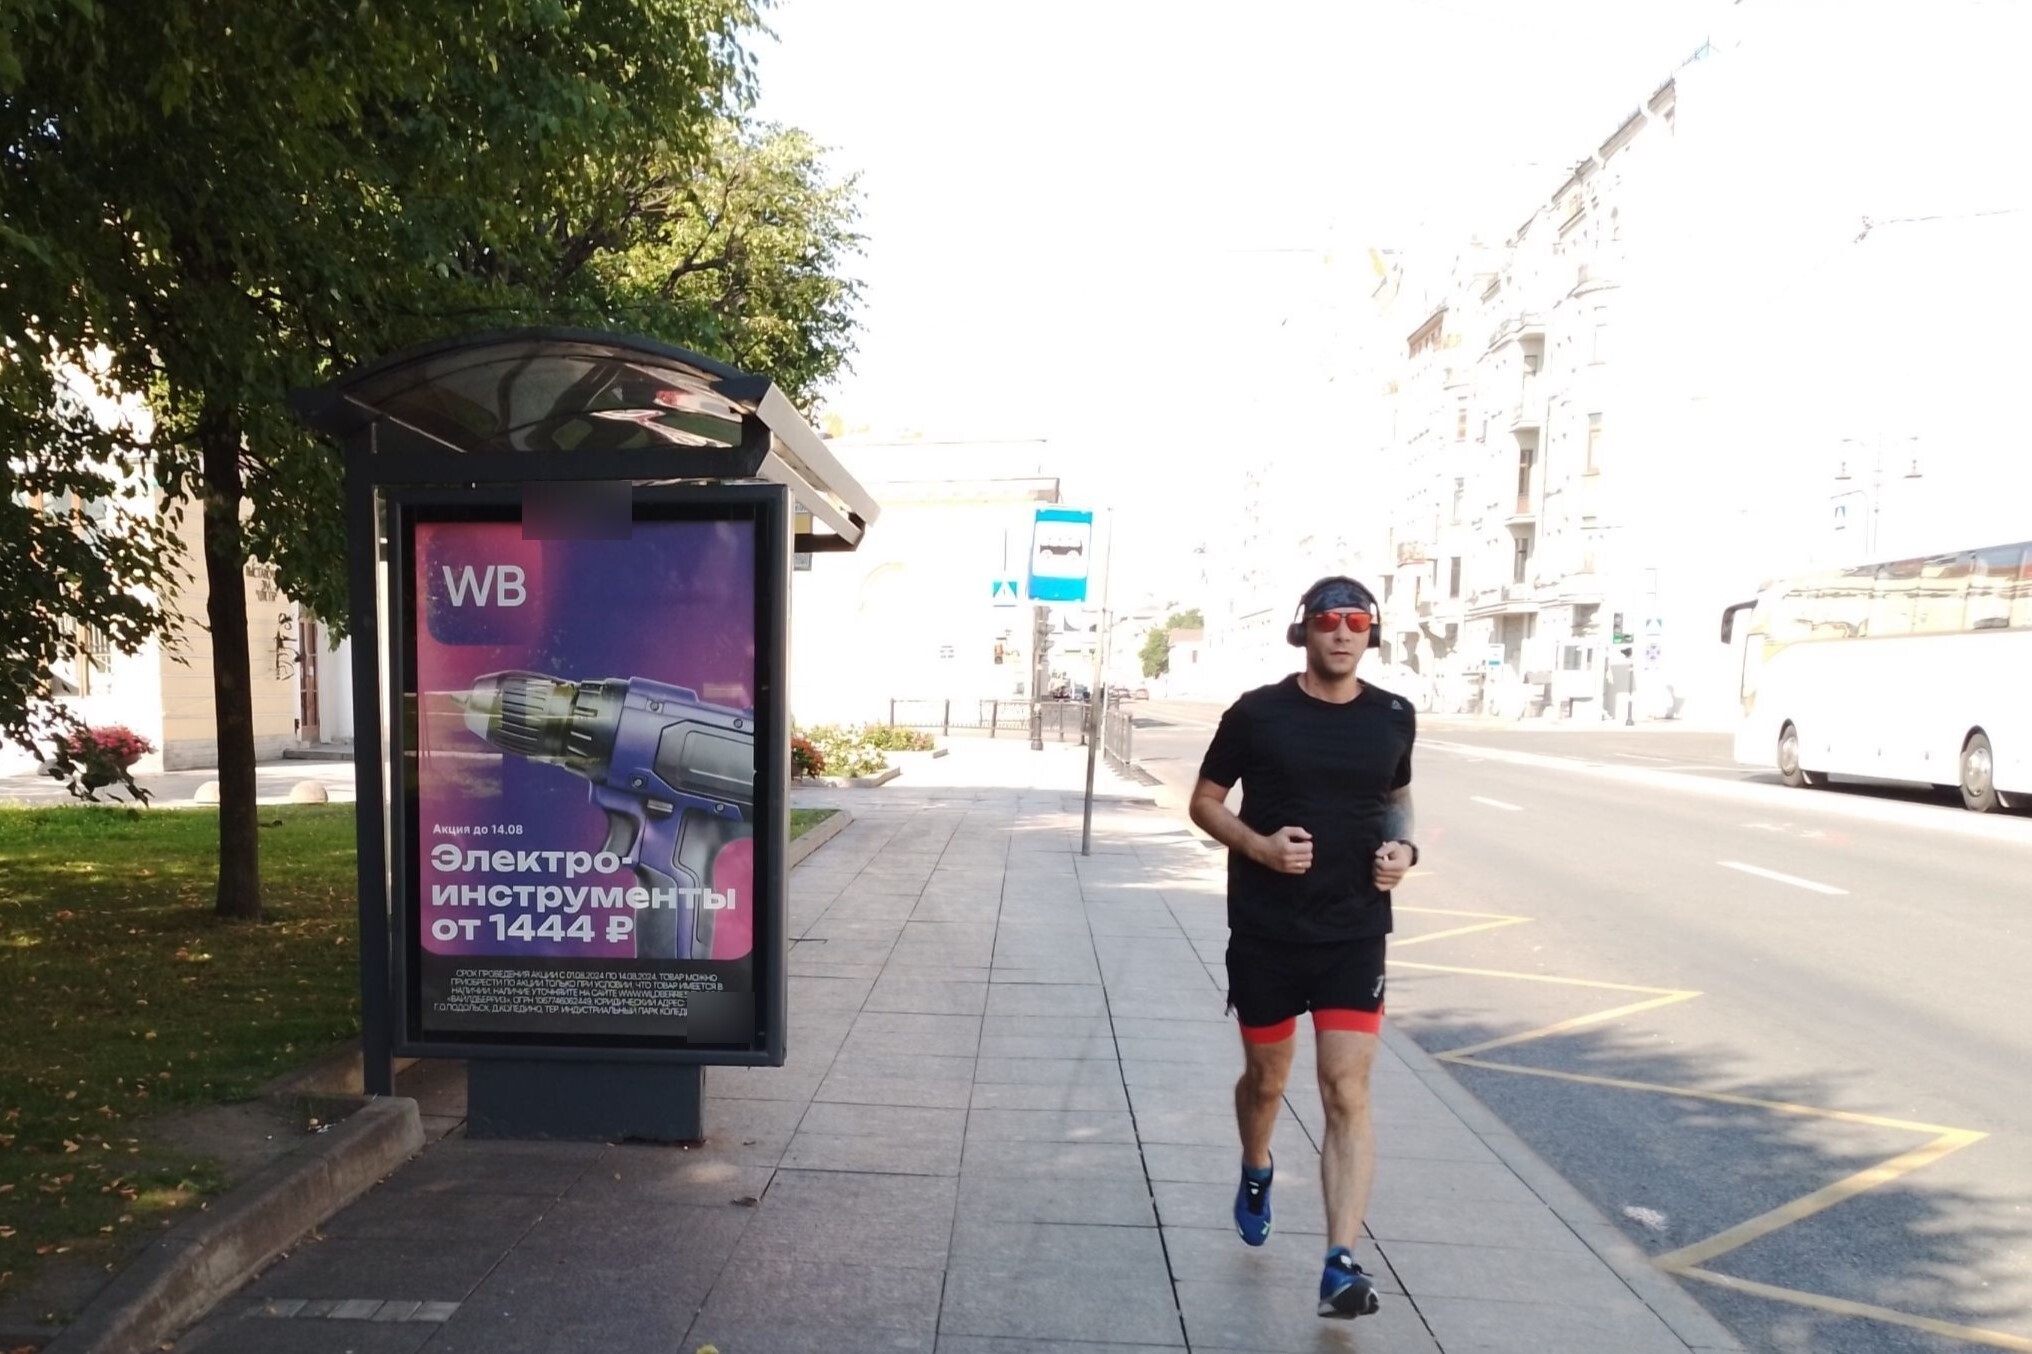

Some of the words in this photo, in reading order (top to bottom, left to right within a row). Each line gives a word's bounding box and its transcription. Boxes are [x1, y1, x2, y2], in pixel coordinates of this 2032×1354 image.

[442, 565, 527, 607] WB
[433, 823, 470, 836] Акция
[473, 826, 488, 836] до
[491, 824, 523, 835] 14.08
[431, 844, 632, 878] Электро-
[431, 884, 736, 913] инструменты
[431, 918, 481, 941] от
[489, 914, 595, 942] 1444
[456, 969, 477, 977] СРОК
[478, 970, 530, 979] ПРОВЕДЕНИЯ
[531, 971, 558, 979] АКЦИИ
[559, 971, 565, 979] С
[605, 972, 617, 980] ПО
[659, 973, 684, 981] ТОВАР
[685, 973, 718, 982] МОЖНО
[450, 978, 502, 986] ПРИОБРЕСТИ
[503, 979, 515, 987] ПО
[516, 979, 543, 987] АКЦИИ
[545, 980, 575, 988] ТОЛЬКО
[576, 980, 593, 988] ПРИ
[679, 982, 716, 990] ИМЕЕТСЯ
[493, 987, 530, 995] НАЛИЧИЕ
[531, 988, 577, 996] УТОЧНЯЙТЕ
[591, 989, 617, 997] САЙТЕ
[512, 996, 534, 1004] ОГРН
[594, 997, 657, 1006] ЮРИДИЧЕСКИЙ
[560, 1006, 637, 1015] ИНДУСТРИАЛЬНЫЙ
[638, 1007, 658, 1015] ПАРК
